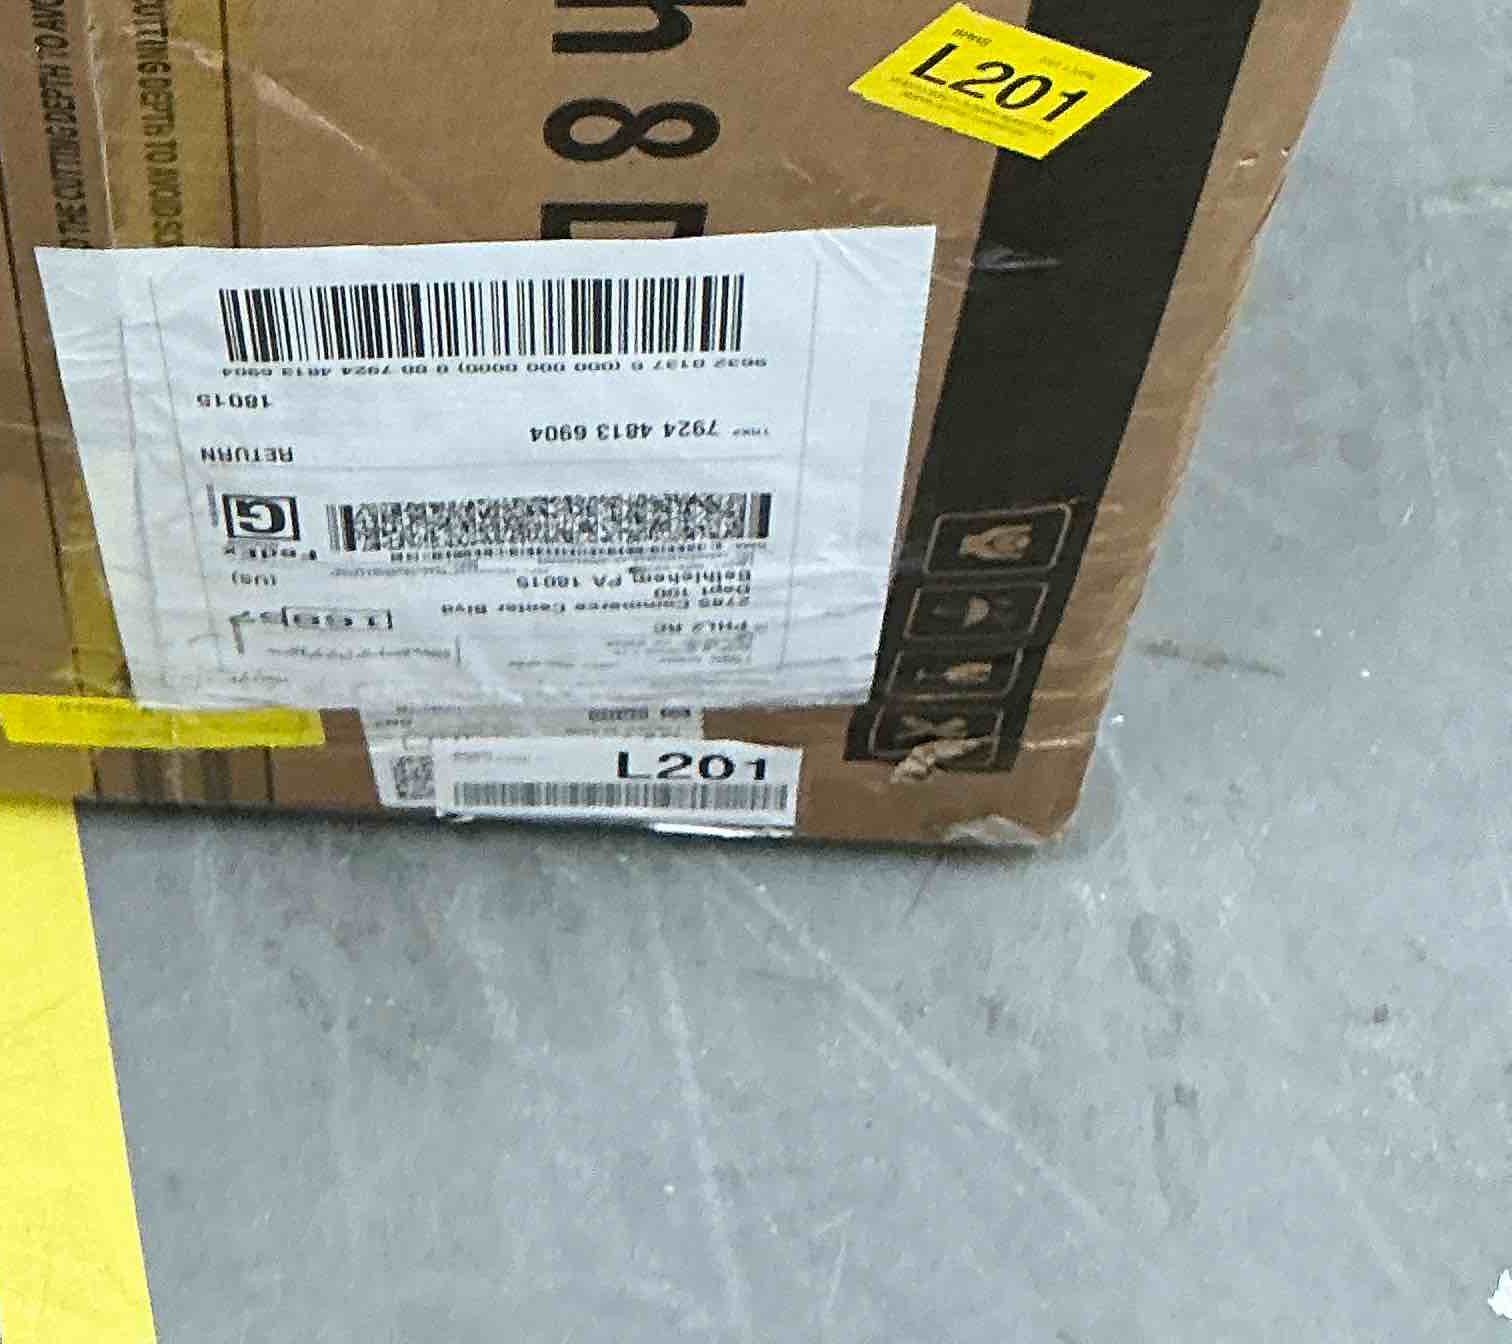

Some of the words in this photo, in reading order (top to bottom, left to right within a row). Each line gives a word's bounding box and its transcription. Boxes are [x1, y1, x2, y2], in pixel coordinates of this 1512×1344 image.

[910, 42, 1089, 123] L201
[541, 96, 722, 163] 8
[194, 391, 273, 410] 18015
[528, 423, 588, 444] 6904
[594, 420, 655, 441] 4813
[661, 418, 720, 440] 7924
[199, 445, 294, 463] RETURN
[234, 498, 285, 536] G
[515, 575, 581, 590] 18015
[591, 573, 623, 588] PA
[616, 749, 767, 782] L201
